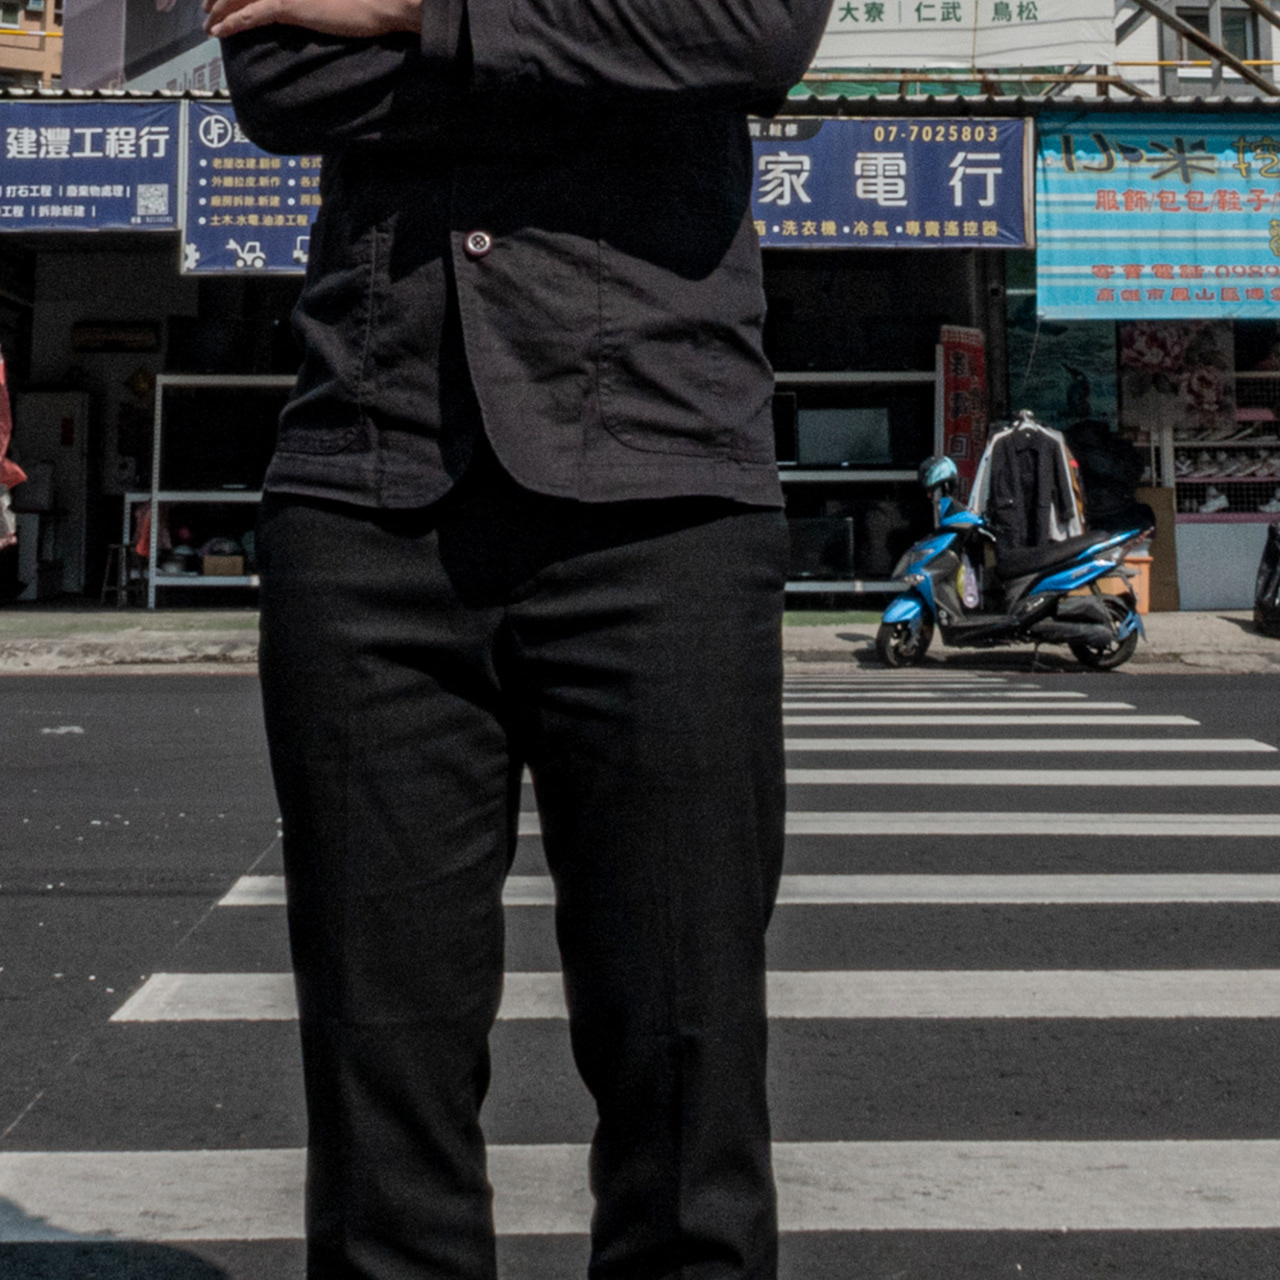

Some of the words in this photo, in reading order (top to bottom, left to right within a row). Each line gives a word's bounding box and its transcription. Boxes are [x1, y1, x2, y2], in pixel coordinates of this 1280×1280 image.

[838, 1, 885, 23] 大寮
[915, 1, 961, 23] 仁武
[992, 0, 1038, 23] 鳥松
[874, 125, 998, 142] 07-7025803
[757, 151, 1003, 207] 家電行
